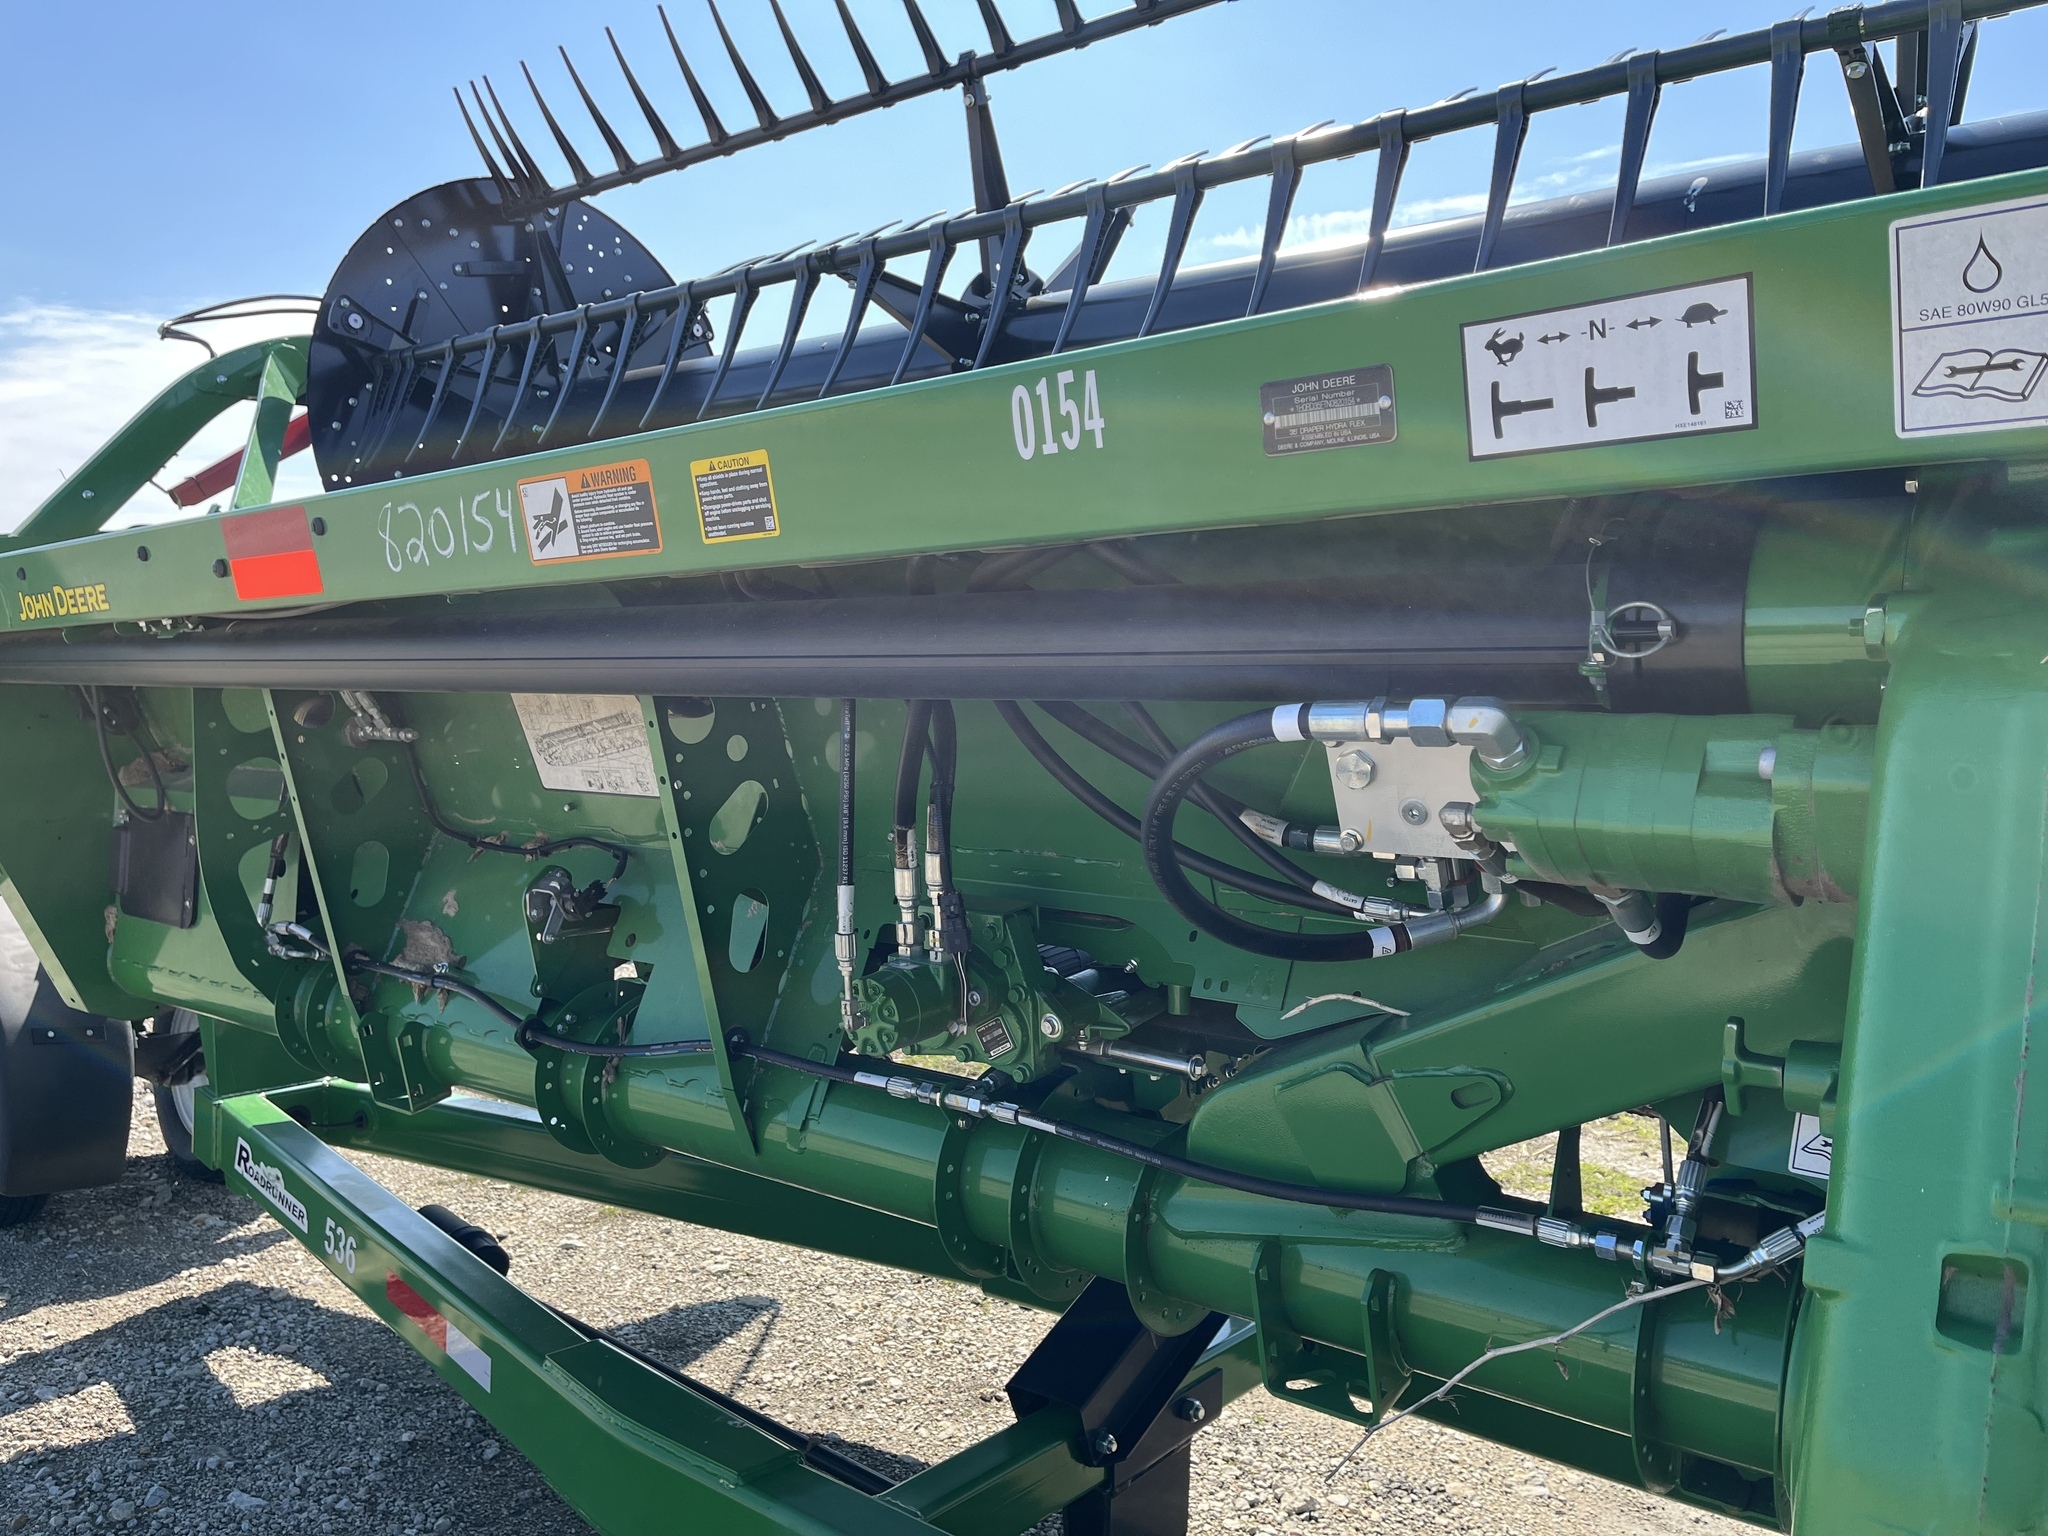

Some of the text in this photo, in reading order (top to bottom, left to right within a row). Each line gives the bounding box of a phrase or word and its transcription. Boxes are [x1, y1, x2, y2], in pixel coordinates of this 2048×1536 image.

[1918, 292, 2048, 322] SAE 80W90 GL5
[1291, 375, 1356, 394] JOHN DEERE
[1294, 389, 1355, 404] Serial Number
[1011, 369, 1105, 461] 0154
[1300, 425, 1324, 435] DRAPER
[1325, 422, 1347, 431] HYDRA
[1349, 419, 1366, 428] FLEX
[1301, 432, 1332, 441] ASSEMBLED
[1277, 443, 1293, 451] DEERE
[717, 457, 750, 470] CAUTION
[590, 466, 637, 487] WARNING
[378, 487, 517, 573] 820154
[18, 583, 110, 622] JOHN DEERE
[237, 1143, 305, 1225] ROADRUNNER
[324, 1216, 357, 1275] 536
